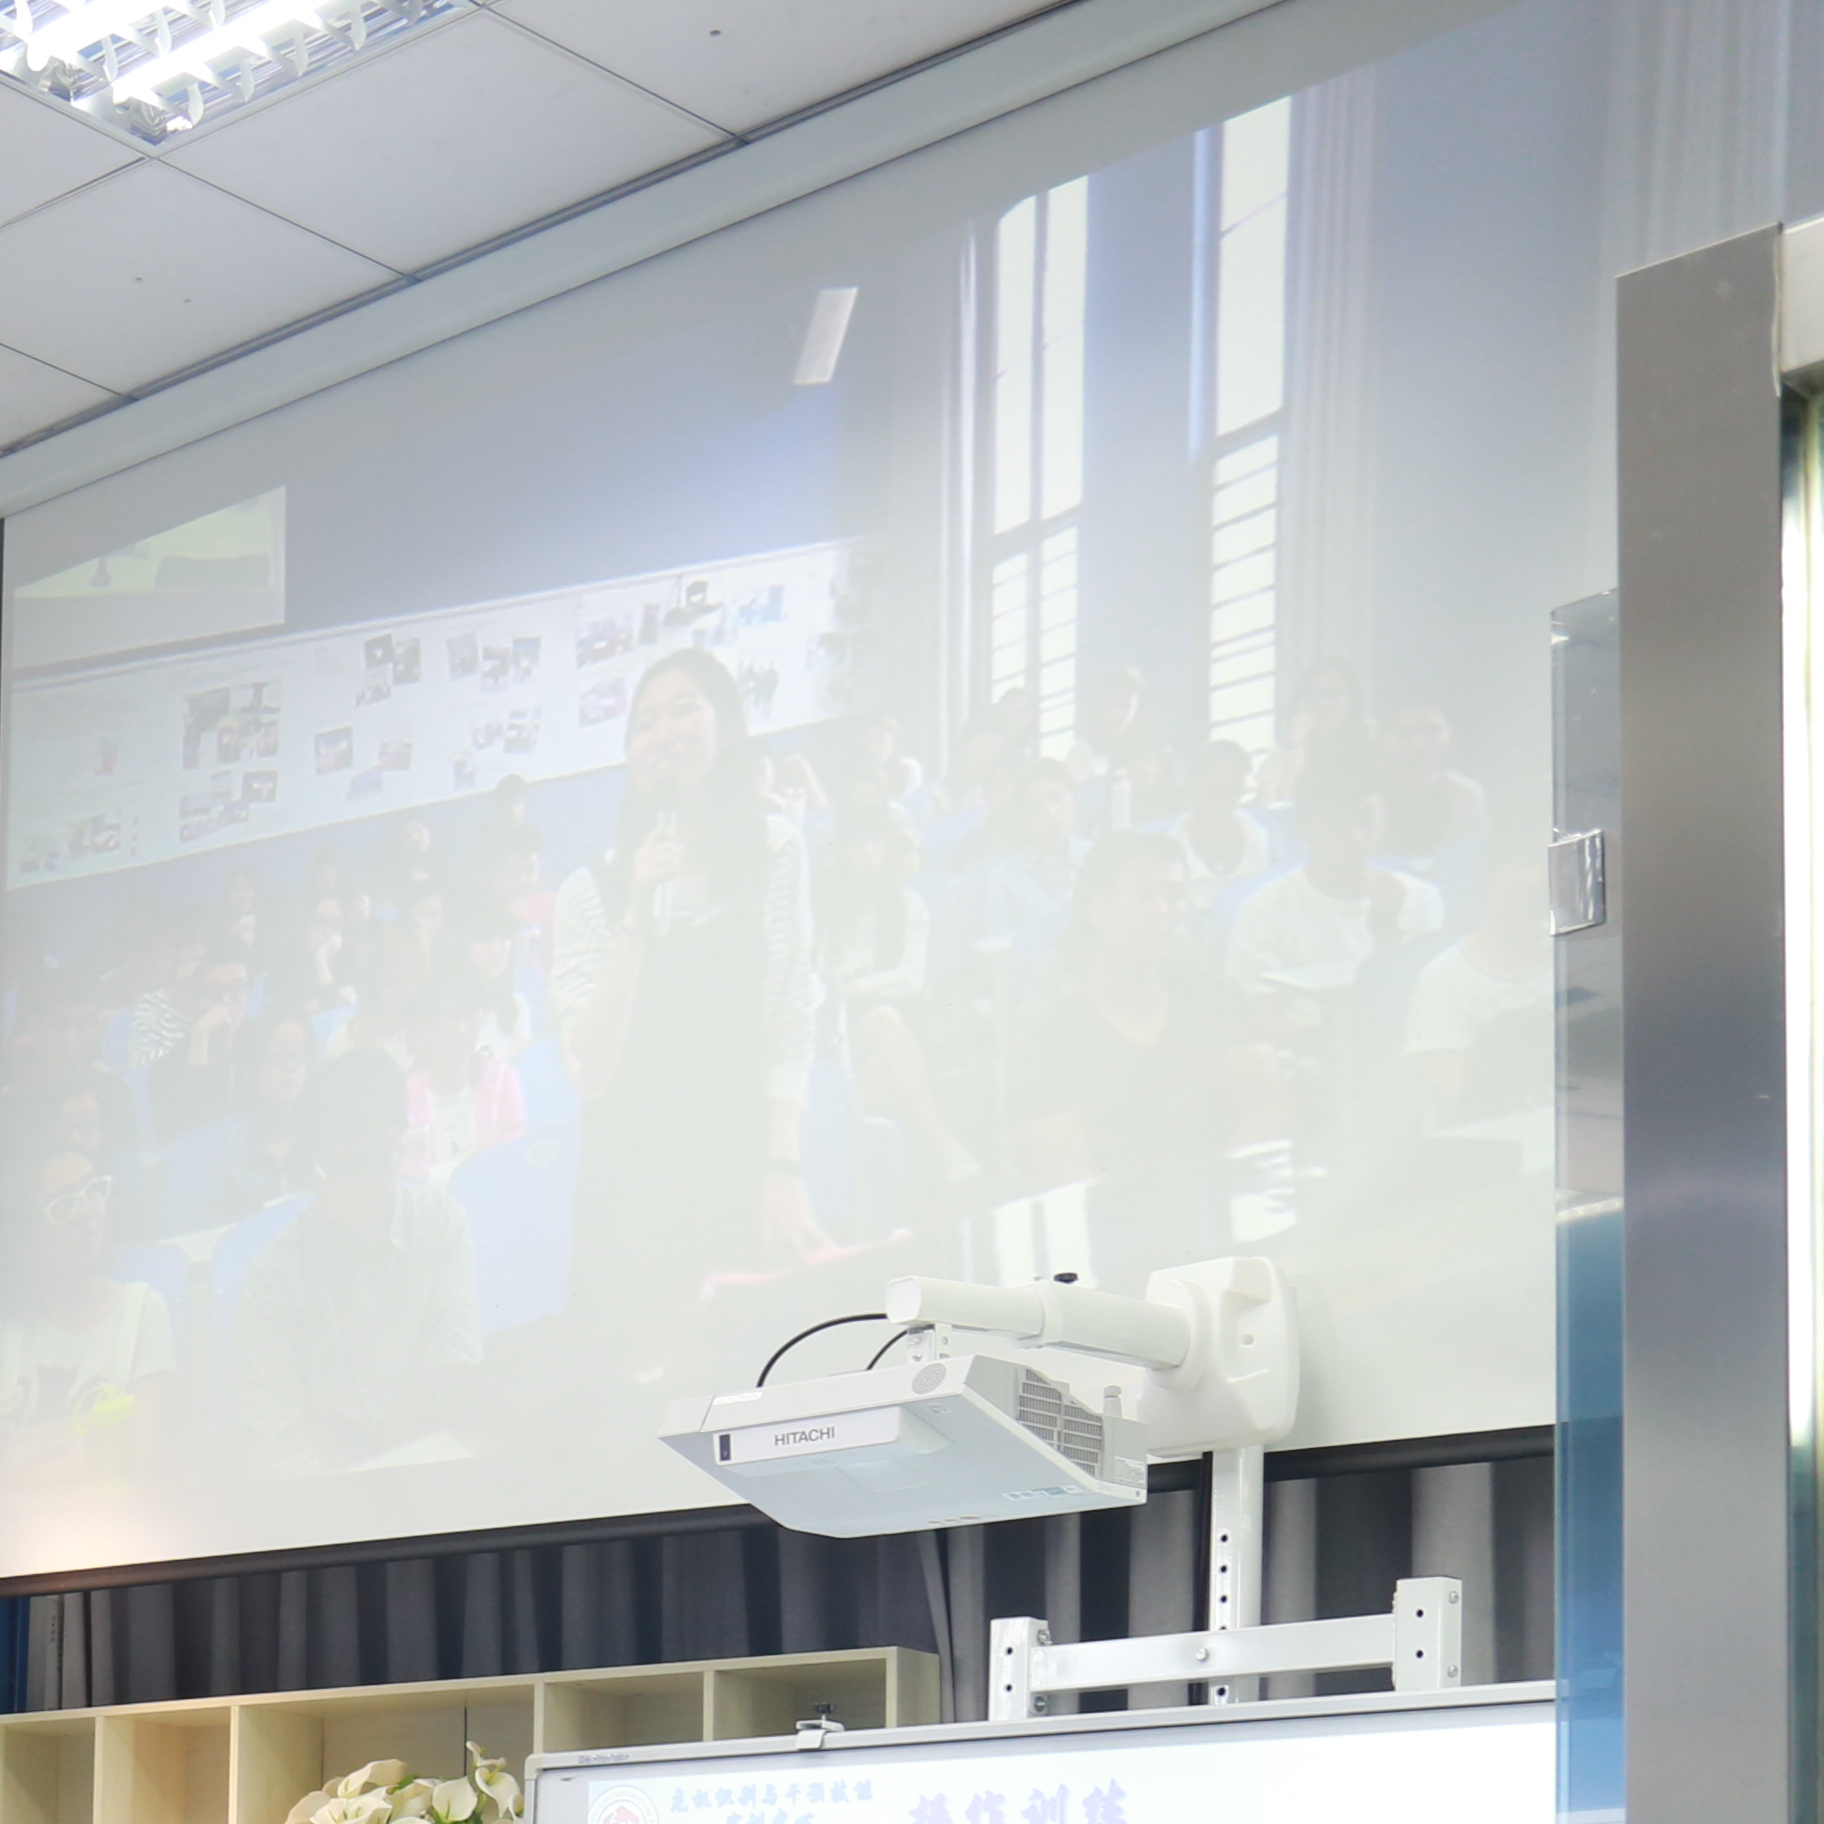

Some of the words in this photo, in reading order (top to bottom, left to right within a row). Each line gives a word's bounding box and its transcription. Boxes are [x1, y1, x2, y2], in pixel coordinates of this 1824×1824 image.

[774, 1426, 835, 1447] HITACHI
[669, 1779, 875, 1814] 危机识别与干预技能
